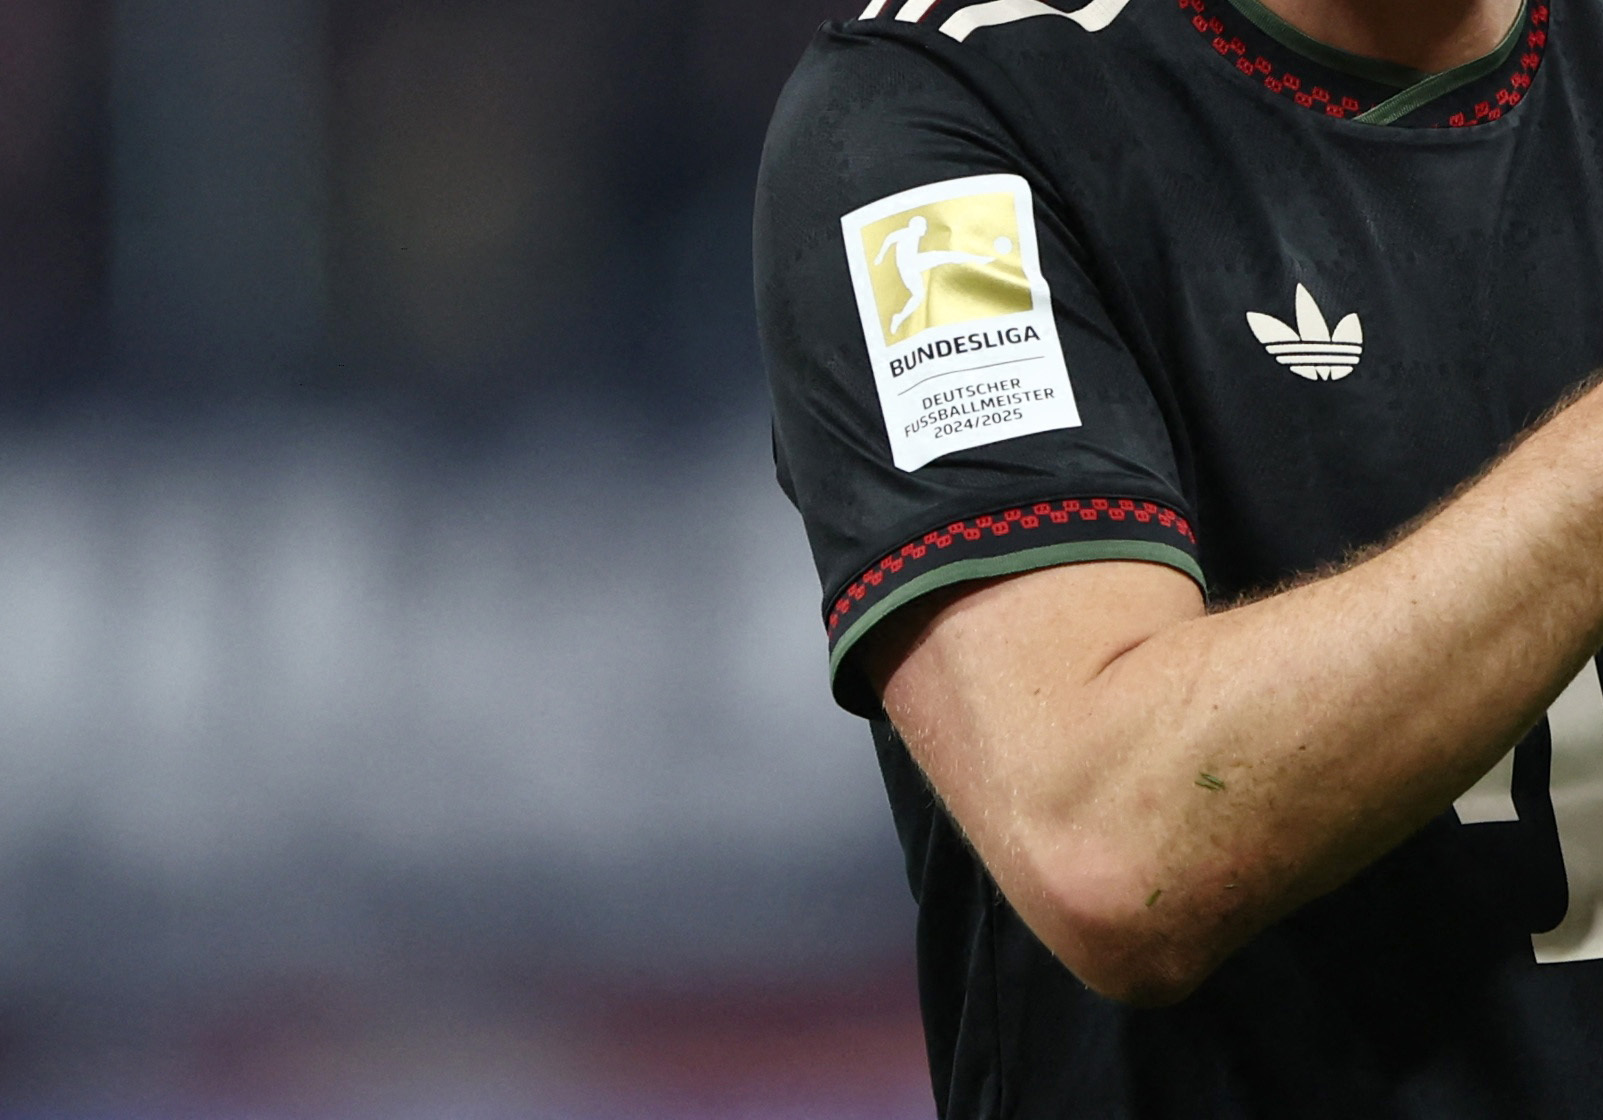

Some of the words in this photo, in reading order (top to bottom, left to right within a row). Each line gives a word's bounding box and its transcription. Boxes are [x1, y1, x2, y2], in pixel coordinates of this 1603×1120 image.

[889, 325, 1040, 378] BUNDESLIGA
[904, 387, 1055, 437] FUSSBALLMEISTER
[922, 378, 1021, 410] DEUTSCHER
[934, 409, 1023, 438] 2024/2025
